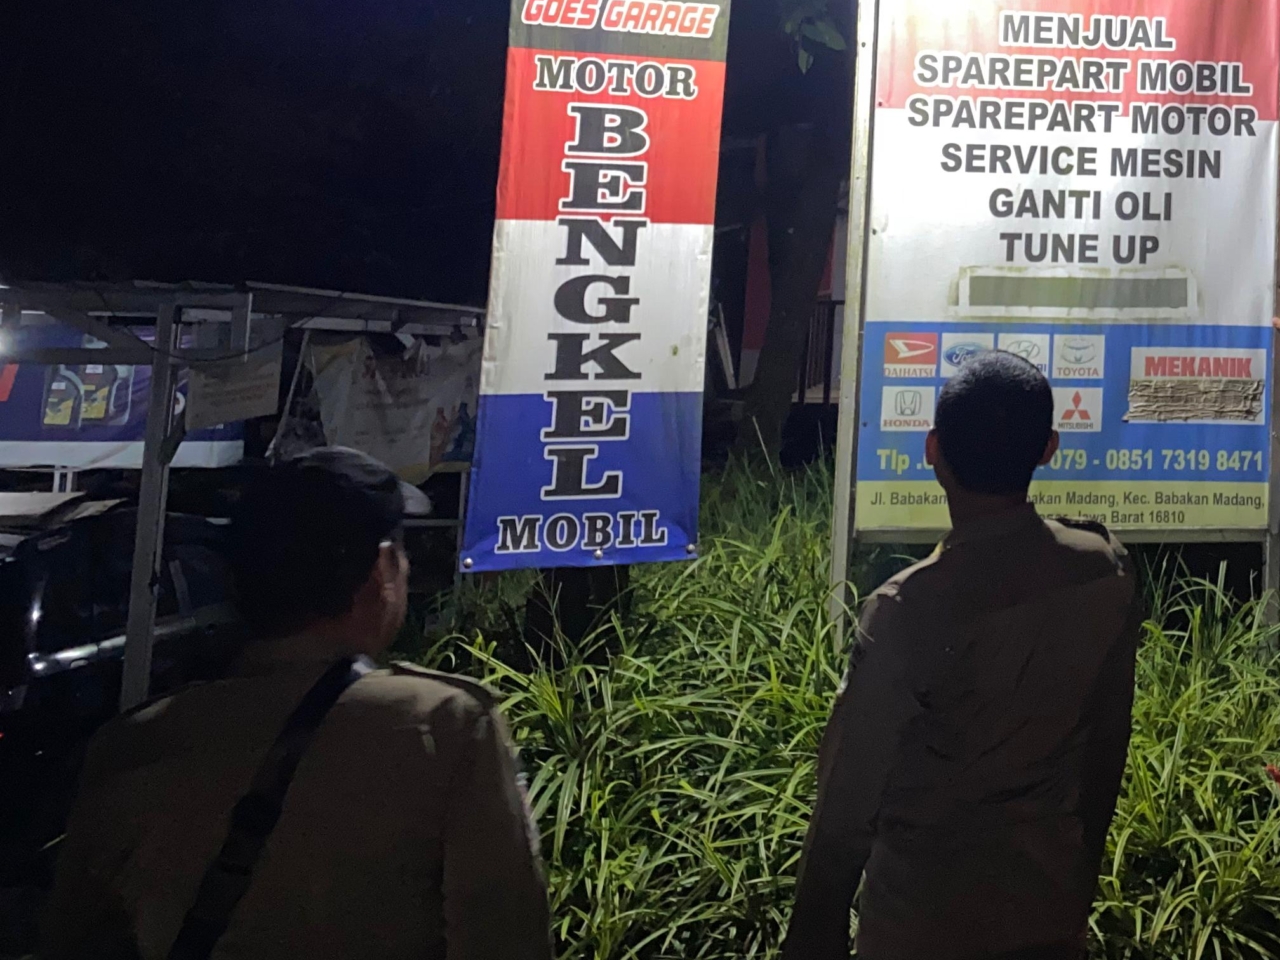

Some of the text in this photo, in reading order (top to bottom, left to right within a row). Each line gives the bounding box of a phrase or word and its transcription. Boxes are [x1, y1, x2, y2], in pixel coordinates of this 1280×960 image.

[1002, 14, 1174, 49] MENJUAL
[534, 56, 697, 99] MOTOR
[917, 54, 1250, 94] SPAREPART MOBIL
[908, 98, 1256, 136] SPAREPART MOTOR
[940, 143, 1221, 179] SERVICE MESIN
[988, 188, 1172, 221] GANTI OLI
[1000, 232, 1160, 265] TUNE UP
[541, 104, 650, 500] BENGKEL
[1056, 367, 1099, 377] TOYOTA
[1144, 356, 1252, 378] MEKANIK
[883, 418, 931, 428] HONDA
[1058, 422, 1094, 430] MITSUBISHI
[876, 449, 910, 475] Tlp
[1106, 449, 1153, 470] 0851
[1161, 449, 1210, 470] 7319
[1216, 450, 1262, 471] 8471
[871, 491, 948, 505] Jl. Babakan
[1066, 492, 1119, 507] Madang,
[1123, 492, 1150, 505] Kec.
[1155, 492, 1209, 505] Babakan
[1213, 493, 1265, 509] Madang,
[495, 511, 668, 553] MOBIL
[1111, 511, 1144, 524] Barat
[1149, 511, 1185, 524] 16810
